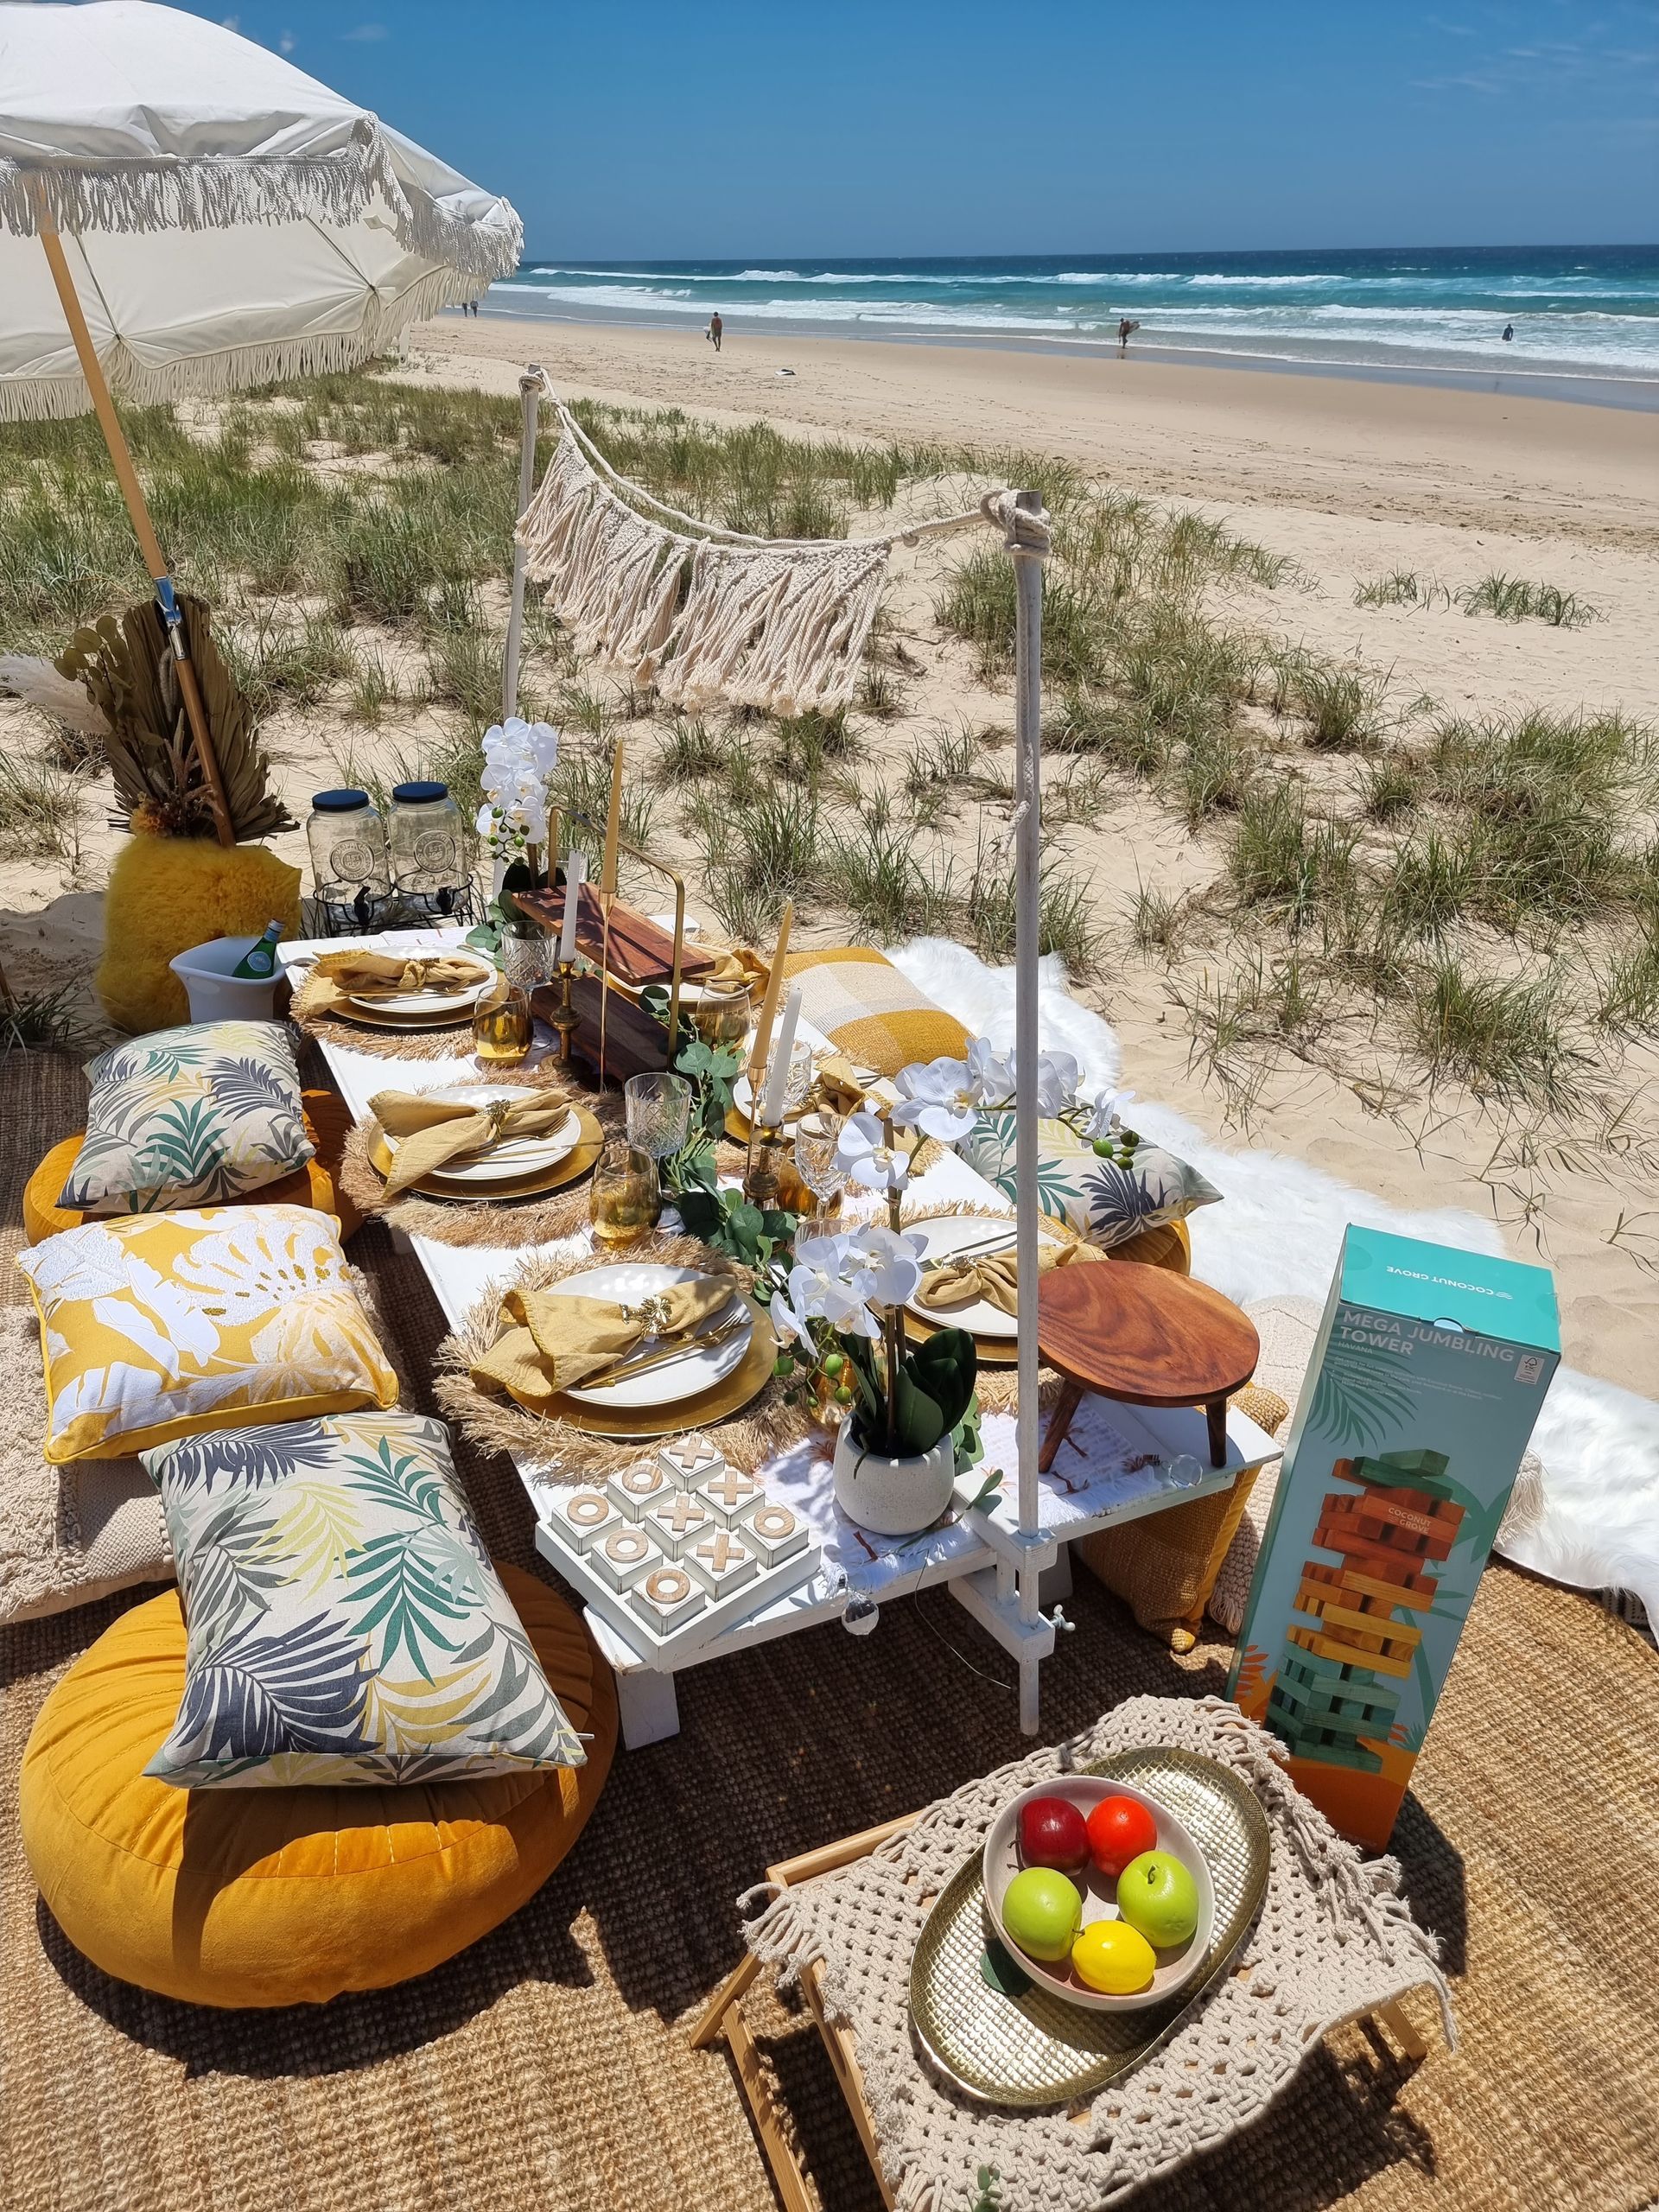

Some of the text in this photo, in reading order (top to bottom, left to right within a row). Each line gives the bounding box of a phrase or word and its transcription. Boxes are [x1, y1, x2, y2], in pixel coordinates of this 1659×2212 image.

[1387, 1267, 1493, 1295] COCONUT GROVE
[1338, 1341, 1372, 1354] HAVANA
[1341, 1325, 1414, 1356] TOWER
[1343, 1311, 1515, 1362] MEGA JUMBLING
[1389, 1508, 1431, 1526] COCONUT
[1399, 1519, 1431, 1534] GROVE
